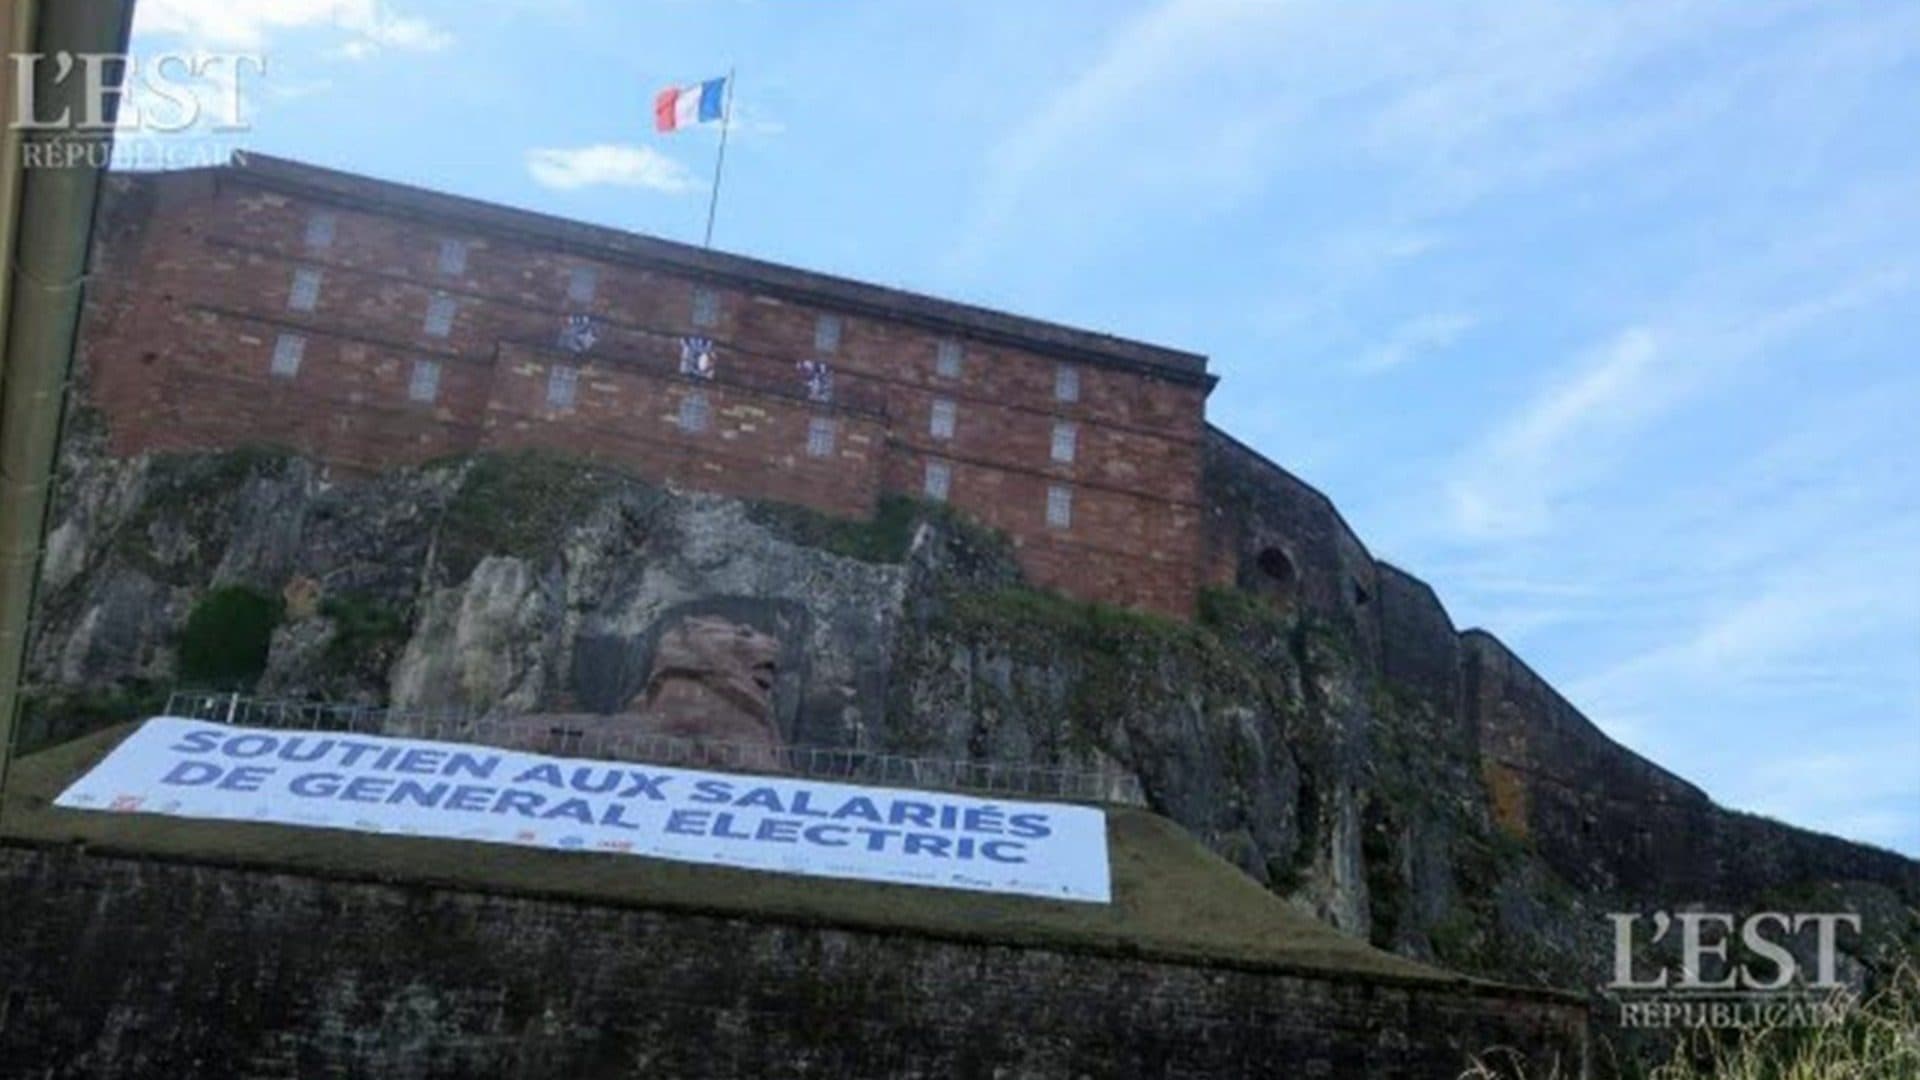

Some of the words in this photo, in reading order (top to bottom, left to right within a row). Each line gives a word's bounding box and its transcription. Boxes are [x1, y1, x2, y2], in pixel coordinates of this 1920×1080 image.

[161, 760, 276, 791] DE
[288, 772, 640, 830] GENERAL
[663, 808, 1028, 864] ELECTRIC
[169, 730, 501, 779] SOUTIEN
[513, 762, 675, 800] AUX
[691, 780, 1052, 839] SALARIÉS
